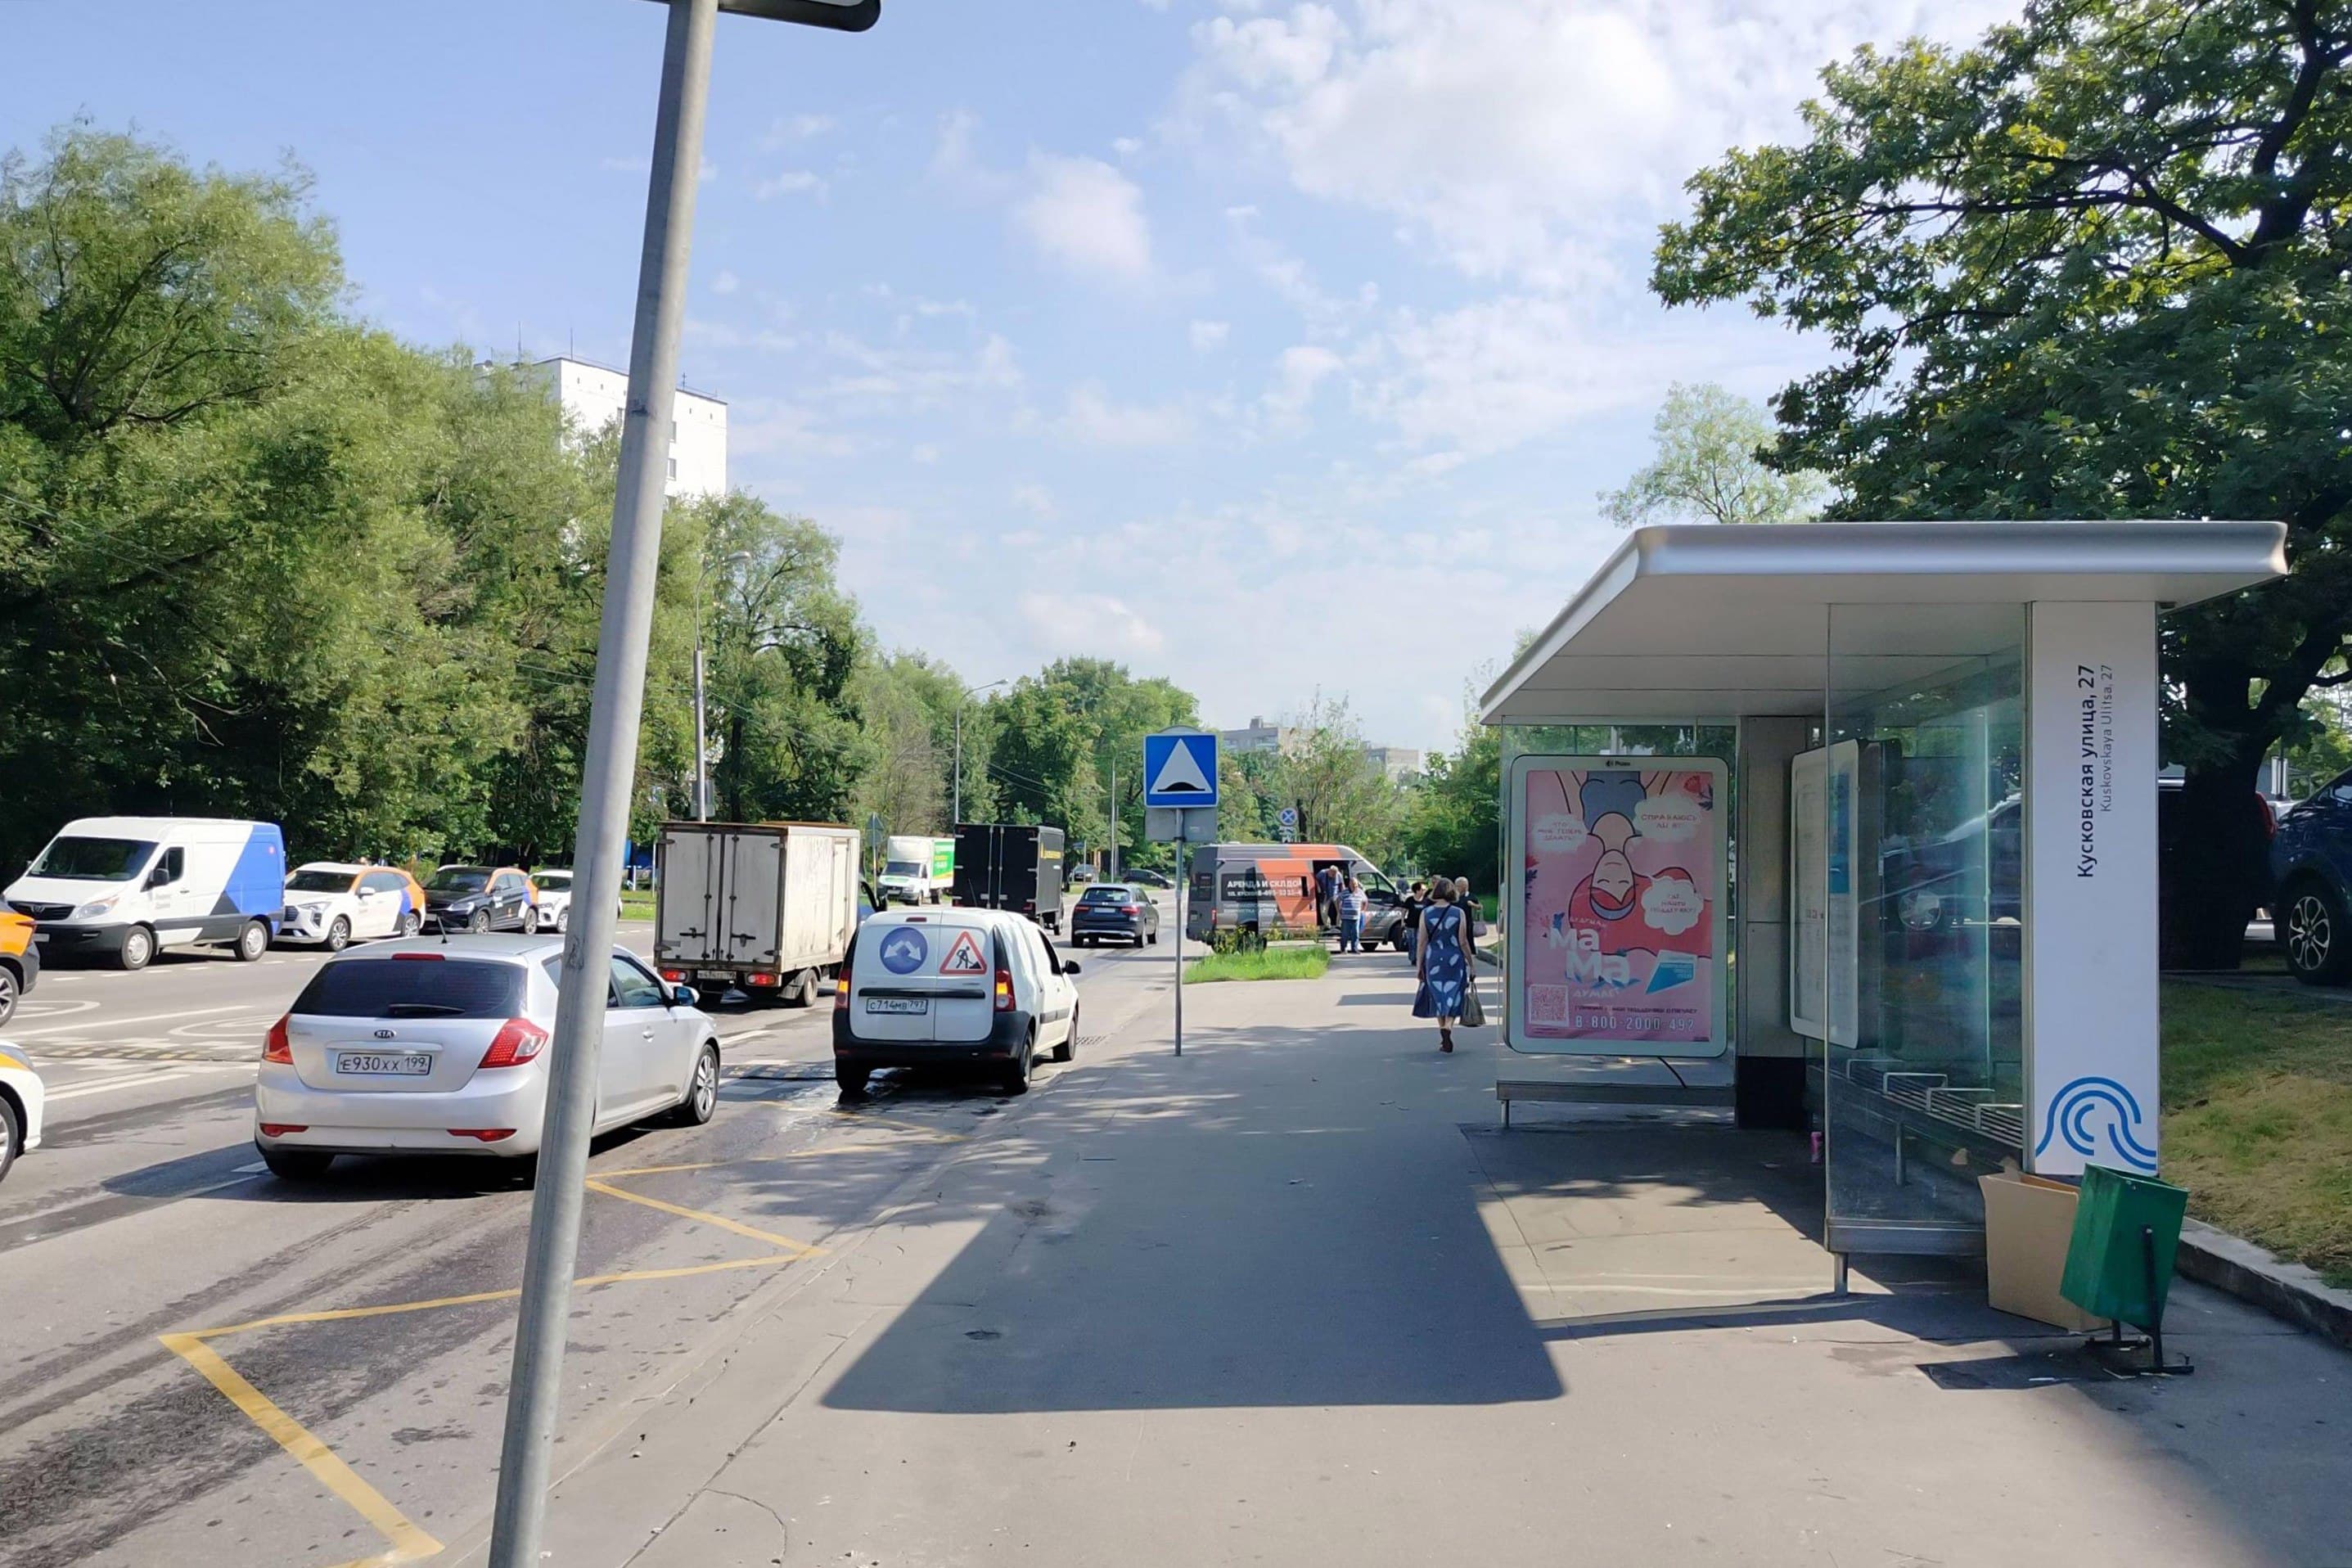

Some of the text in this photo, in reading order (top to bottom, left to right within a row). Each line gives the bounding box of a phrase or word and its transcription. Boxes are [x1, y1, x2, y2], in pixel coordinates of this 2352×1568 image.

[2077, 665, 2098, 877] Кусковская улица, 27
[2099, 665, 2115, 812] Kuskovskaya Ulitsa, 27
[376, 1030, 394, 1039] KIA
